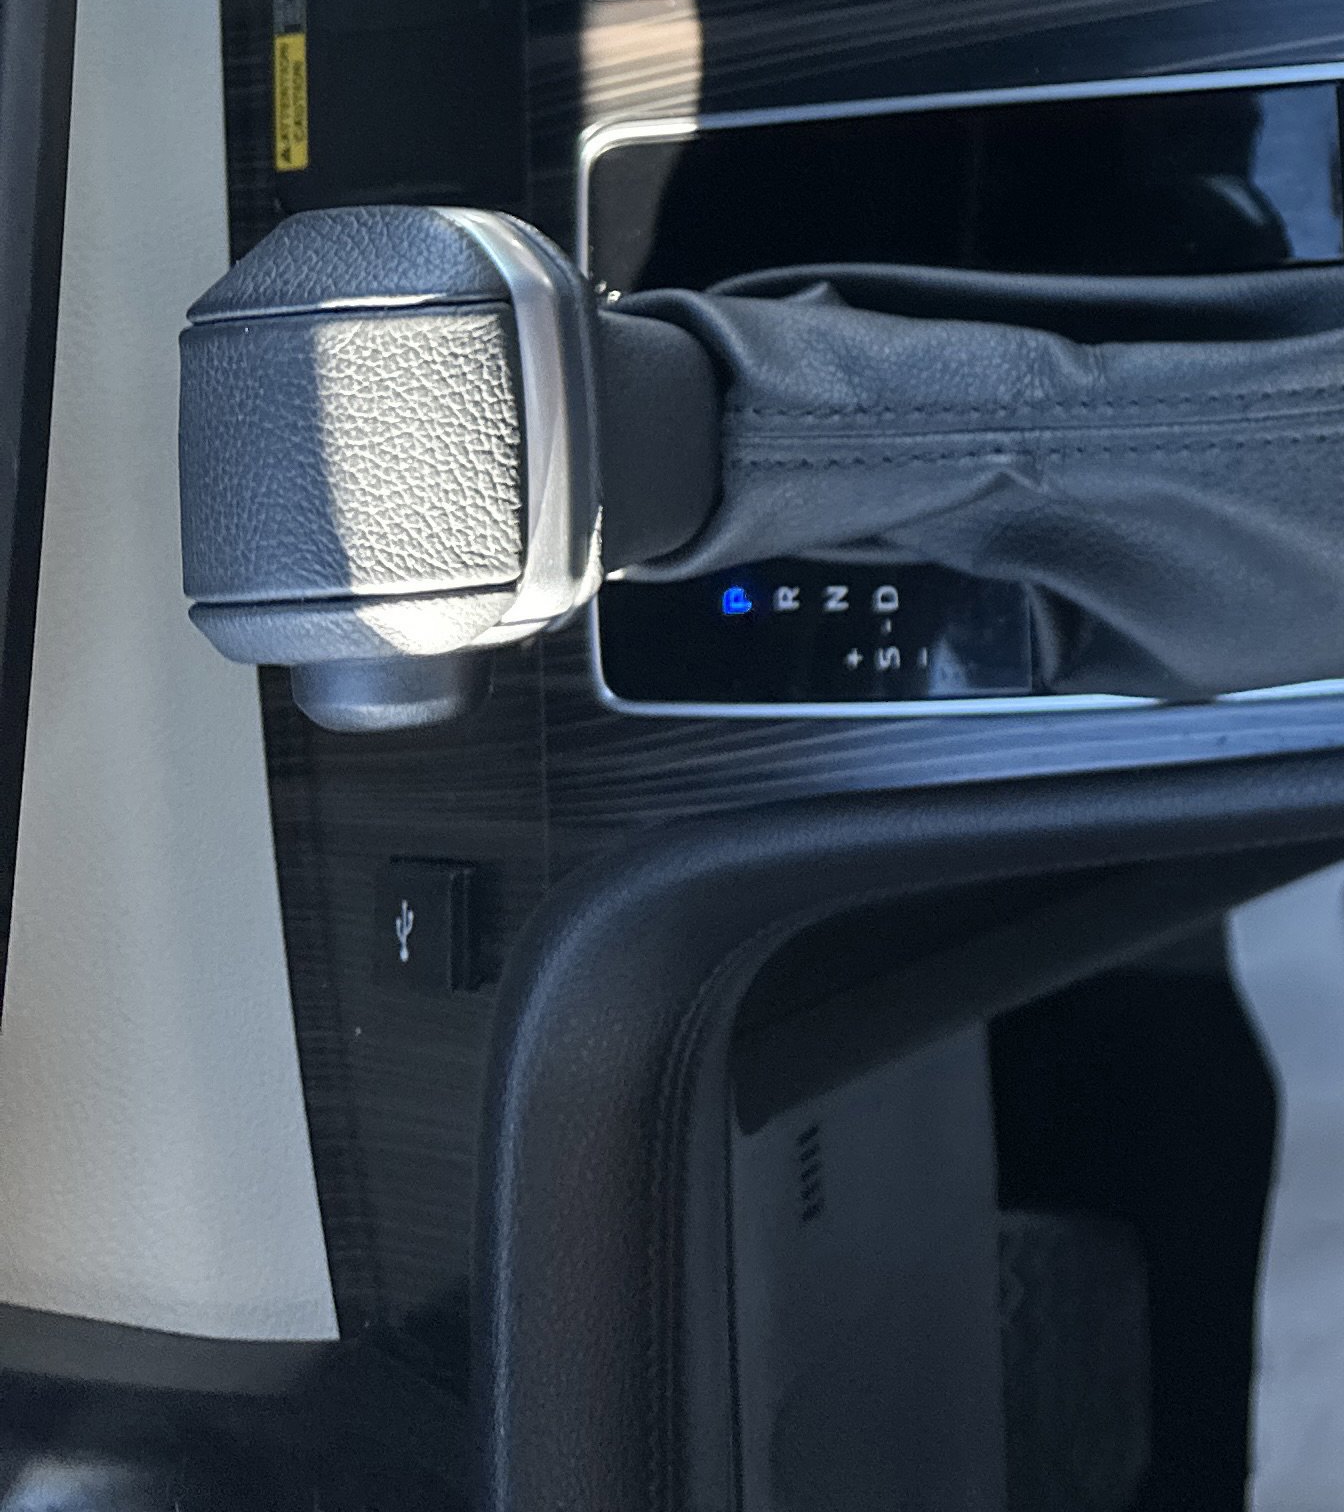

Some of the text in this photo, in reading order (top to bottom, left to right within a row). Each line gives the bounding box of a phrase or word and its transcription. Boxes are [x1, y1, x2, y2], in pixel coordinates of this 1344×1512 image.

[723, 587, 899, 614] P R N D
[876, 647, 900, 669] S
